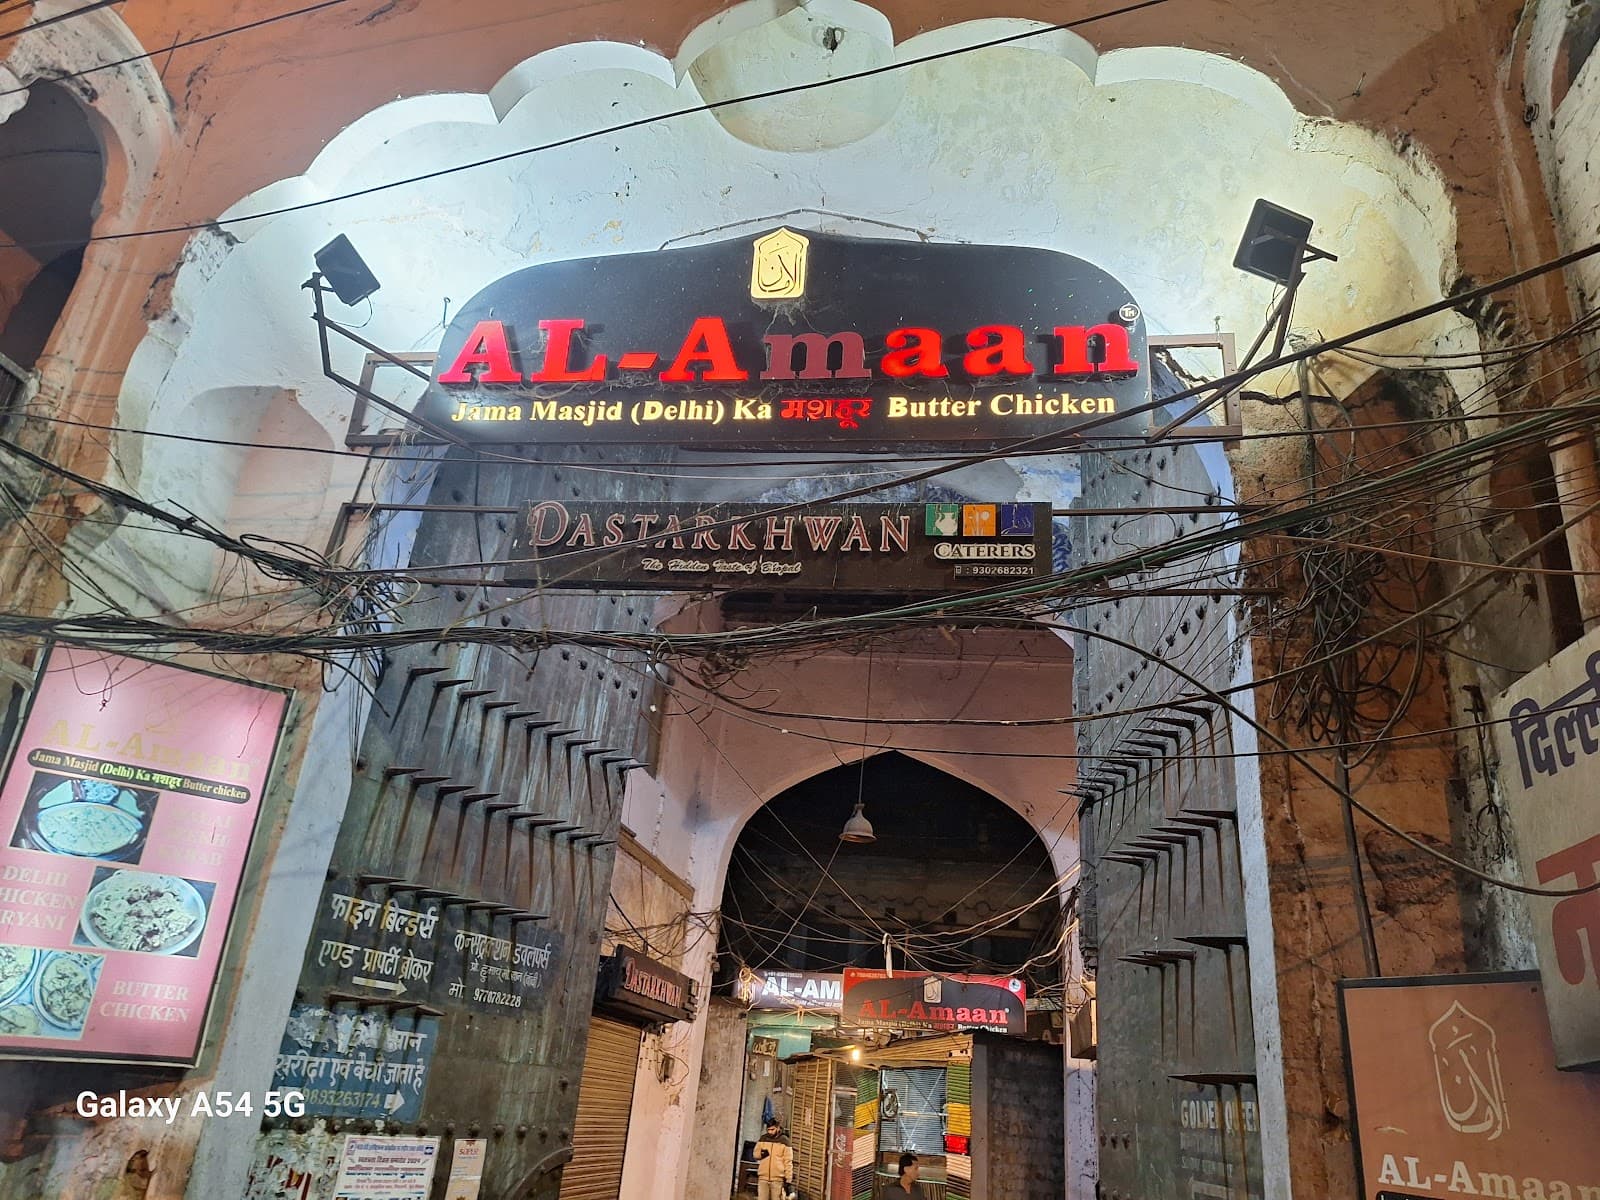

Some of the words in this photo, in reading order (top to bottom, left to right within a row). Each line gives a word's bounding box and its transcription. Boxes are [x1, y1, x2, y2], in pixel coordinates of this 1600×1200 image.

[437, 316, 1140, 384] AL-Amaan
[452, 401, 522, 422] Jama
[530, 400, 622, 426] Masjid
[630, 400, 724, 425] (Delhi)
[733, 399, 772, 421] Ka
[780, 398, 873, 429] मशहूर
[887, 396, 982, 417] Butter
[989, 392, 1116, 416] Chicken
[527, 500, 911, 552] DASTARKHWAN
[641, 558, 664, 571] The
[668, 558, 710, 572] Hidden
[713, 558, 742, 573] Taste
[742, 560, 758, 575] of
[32, 751, 62, 765] Jama
[63, 756, 100, 773] Masjid
[99, 763, 135, 781] (Delhi)
[135, 768, 151, 781] Ka
[151, 773, 183, 789] मशहूर
[183, 778, 213, 793] Butter
[213, 784, 248, 800] chicken
[3, 865, 69, 887] DELHI
[331, 893, 382, 931] फाइन
[318, 940, 362, 969] एण्ड
[398, 949, 435, 984] ब्रोकर
[112, 980, 190, 1001] BUTTER
[100, 1002, 191, 1024] CHICKEN
[859, 1000, 1009, 1025] AL-Amaan
